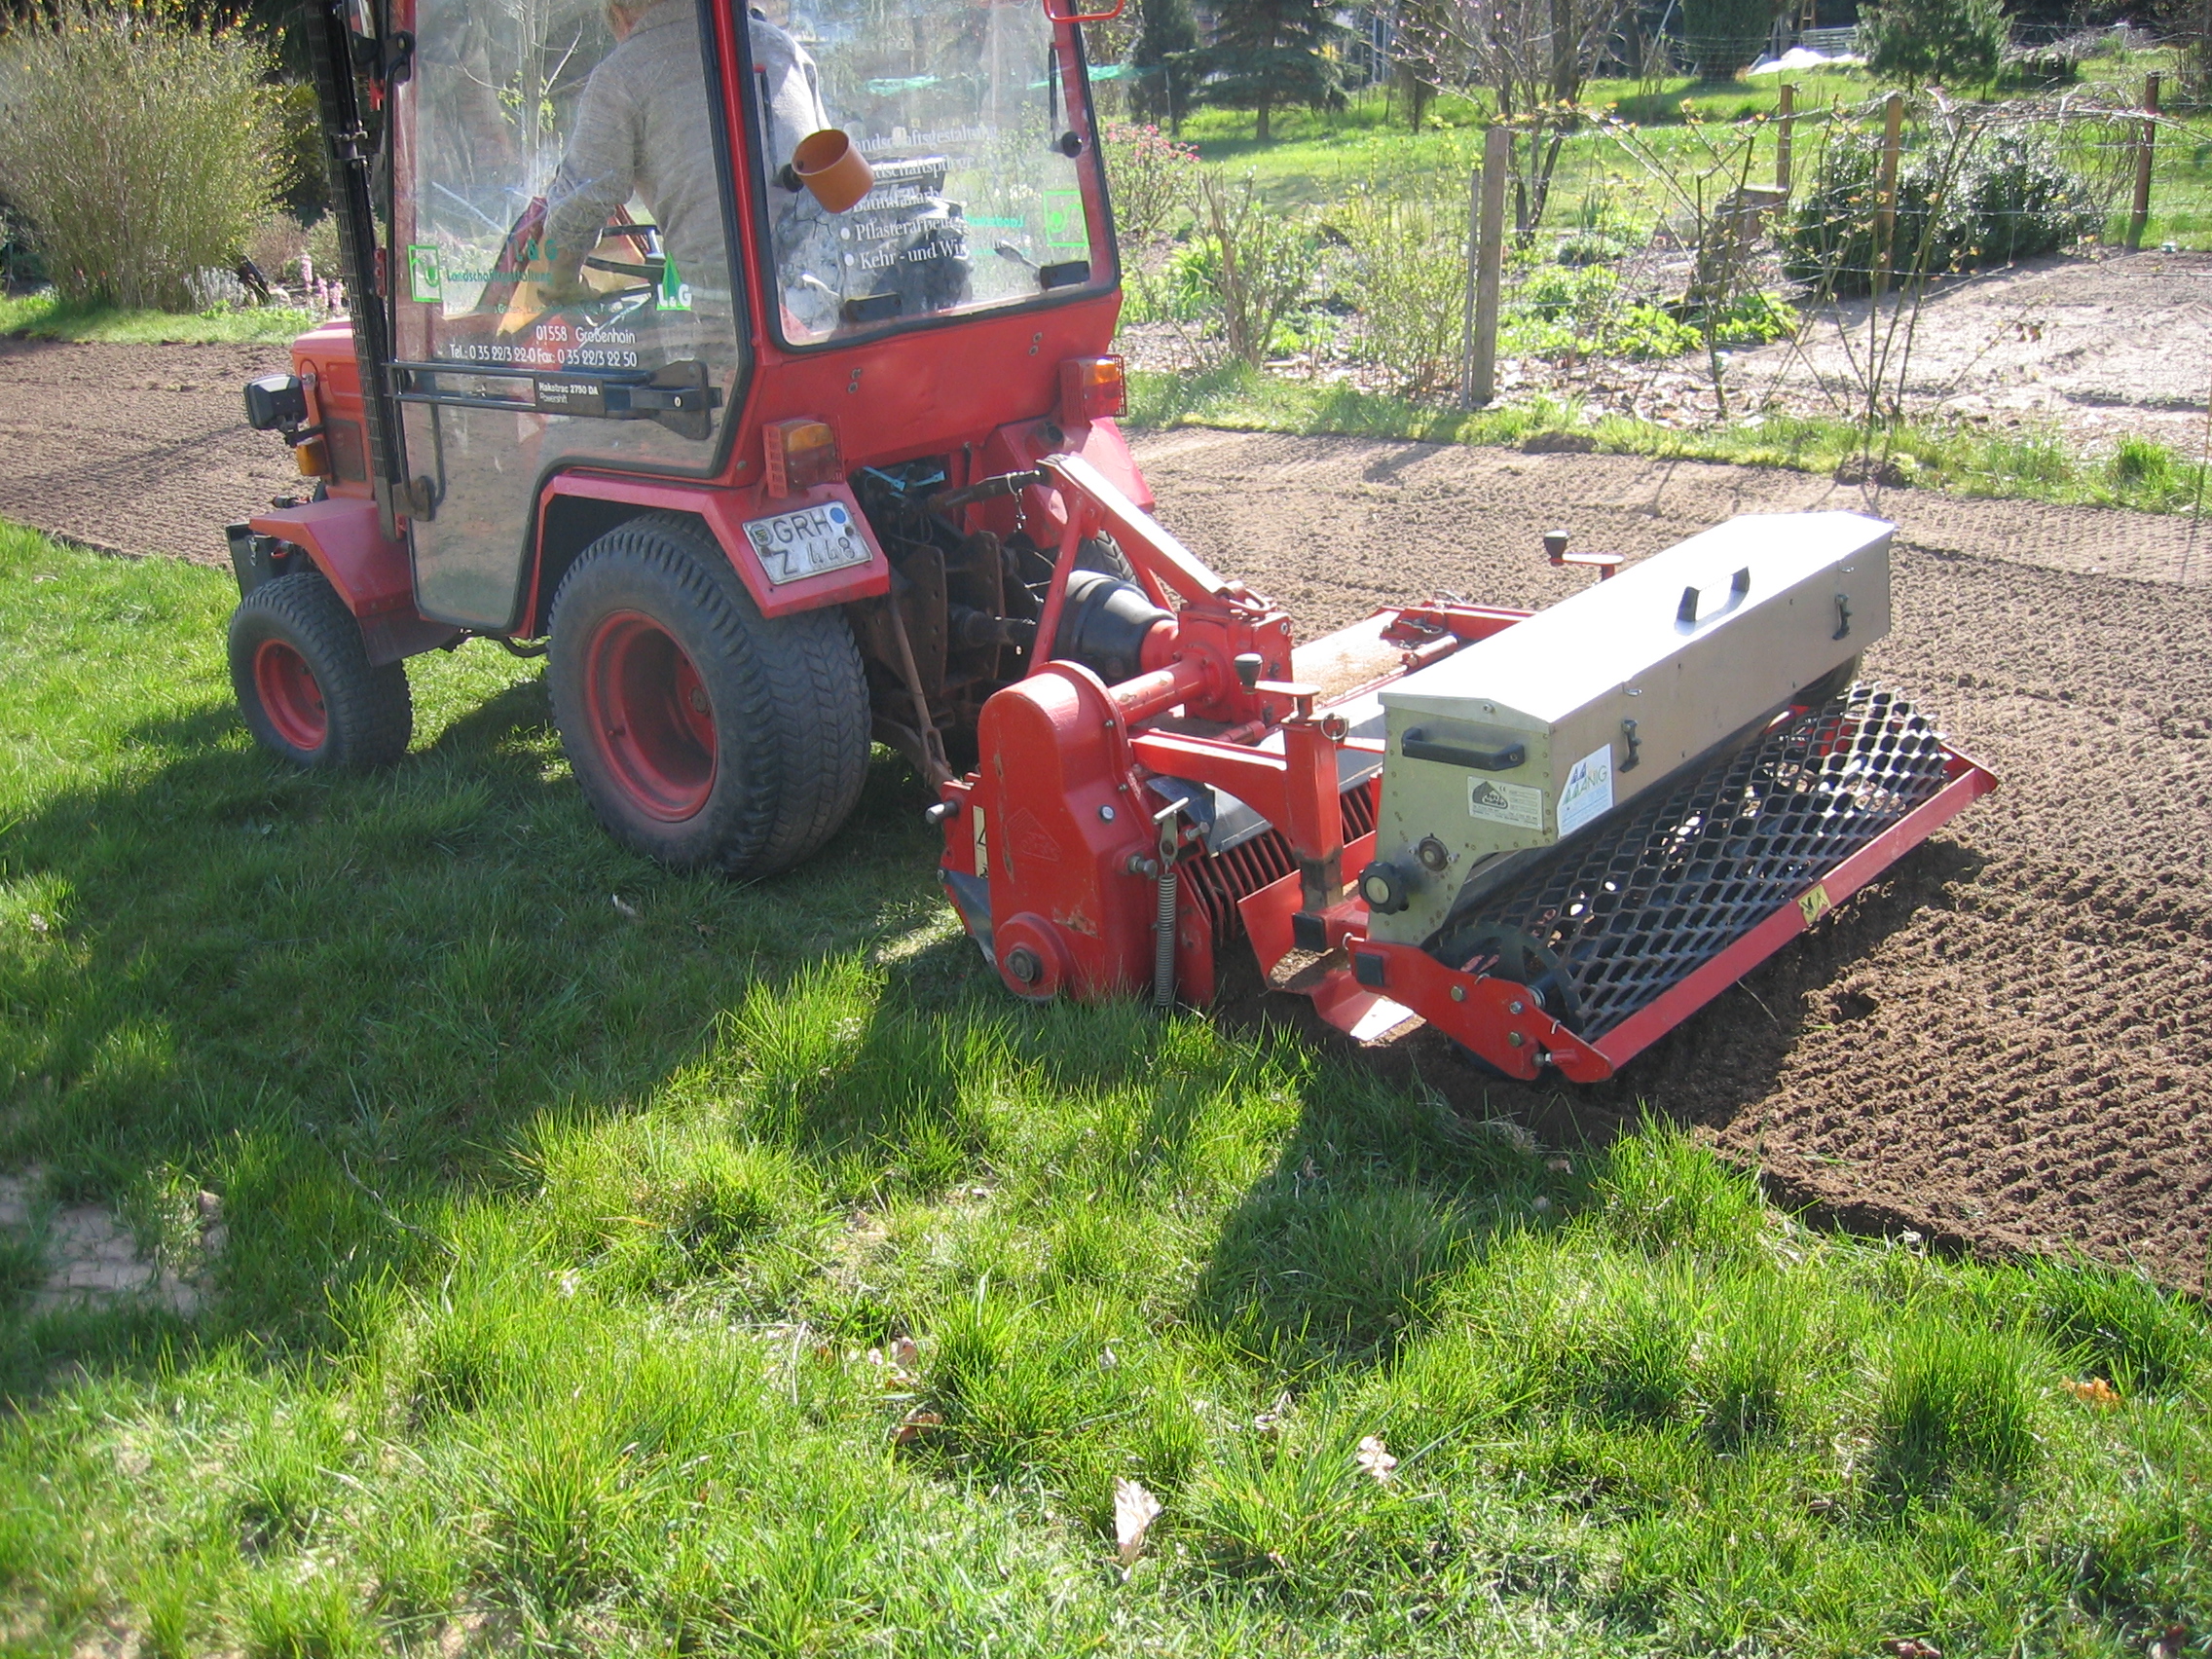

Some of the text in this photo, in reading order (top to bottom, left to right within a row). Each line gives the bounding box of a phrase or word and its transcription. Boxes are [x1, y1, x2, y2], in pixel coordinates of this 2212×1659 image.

[861, 249, 896, 270] Kehr
[907, 241, 939, 263] und
[535, 324, 568, 342] 01558
[478, 346, 491, 360] 35
[567, 350, 579, 365] 35
[773, 507, 833, 543] GRH
[773, 549, 797, 575] Z
